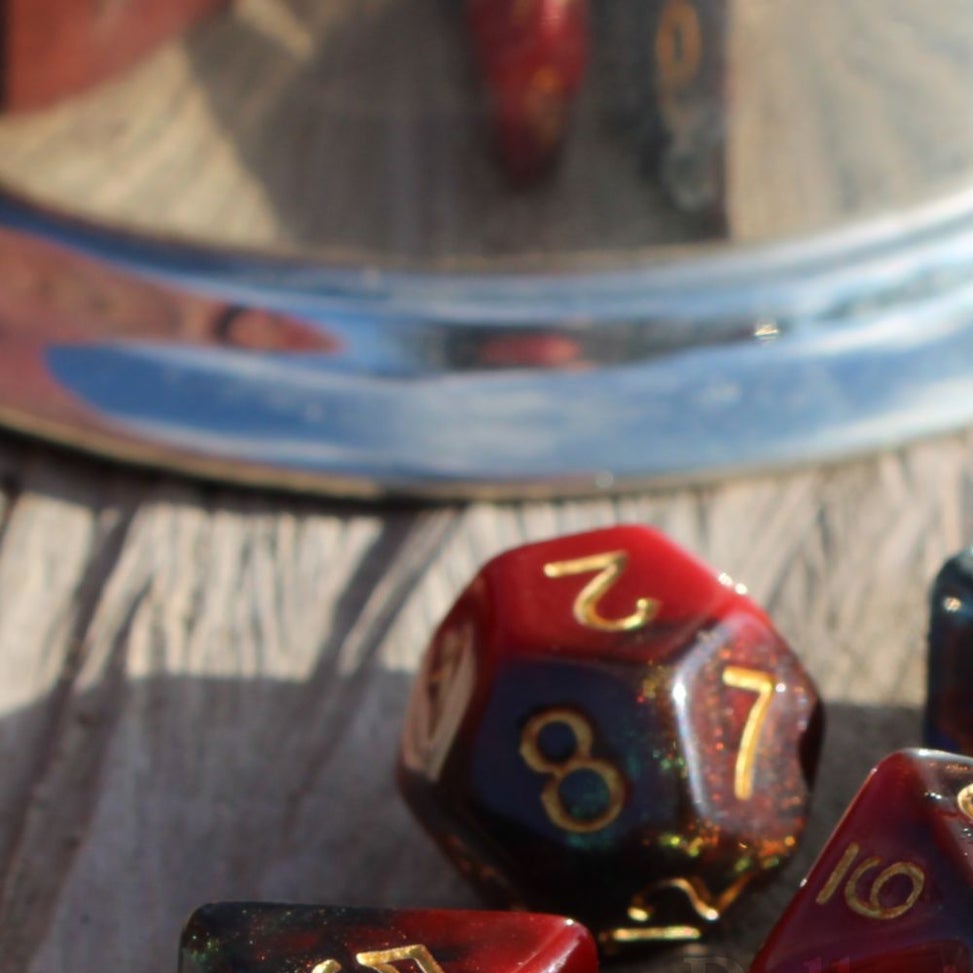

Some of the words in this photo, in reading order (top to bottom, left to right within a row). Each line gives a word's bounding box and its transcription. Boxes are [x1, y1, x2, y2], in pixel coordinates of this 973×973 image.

[543, 549, 660, 632] 2
[518, 708, 629, 833] 8
[722, 665, 776, 801] 7
